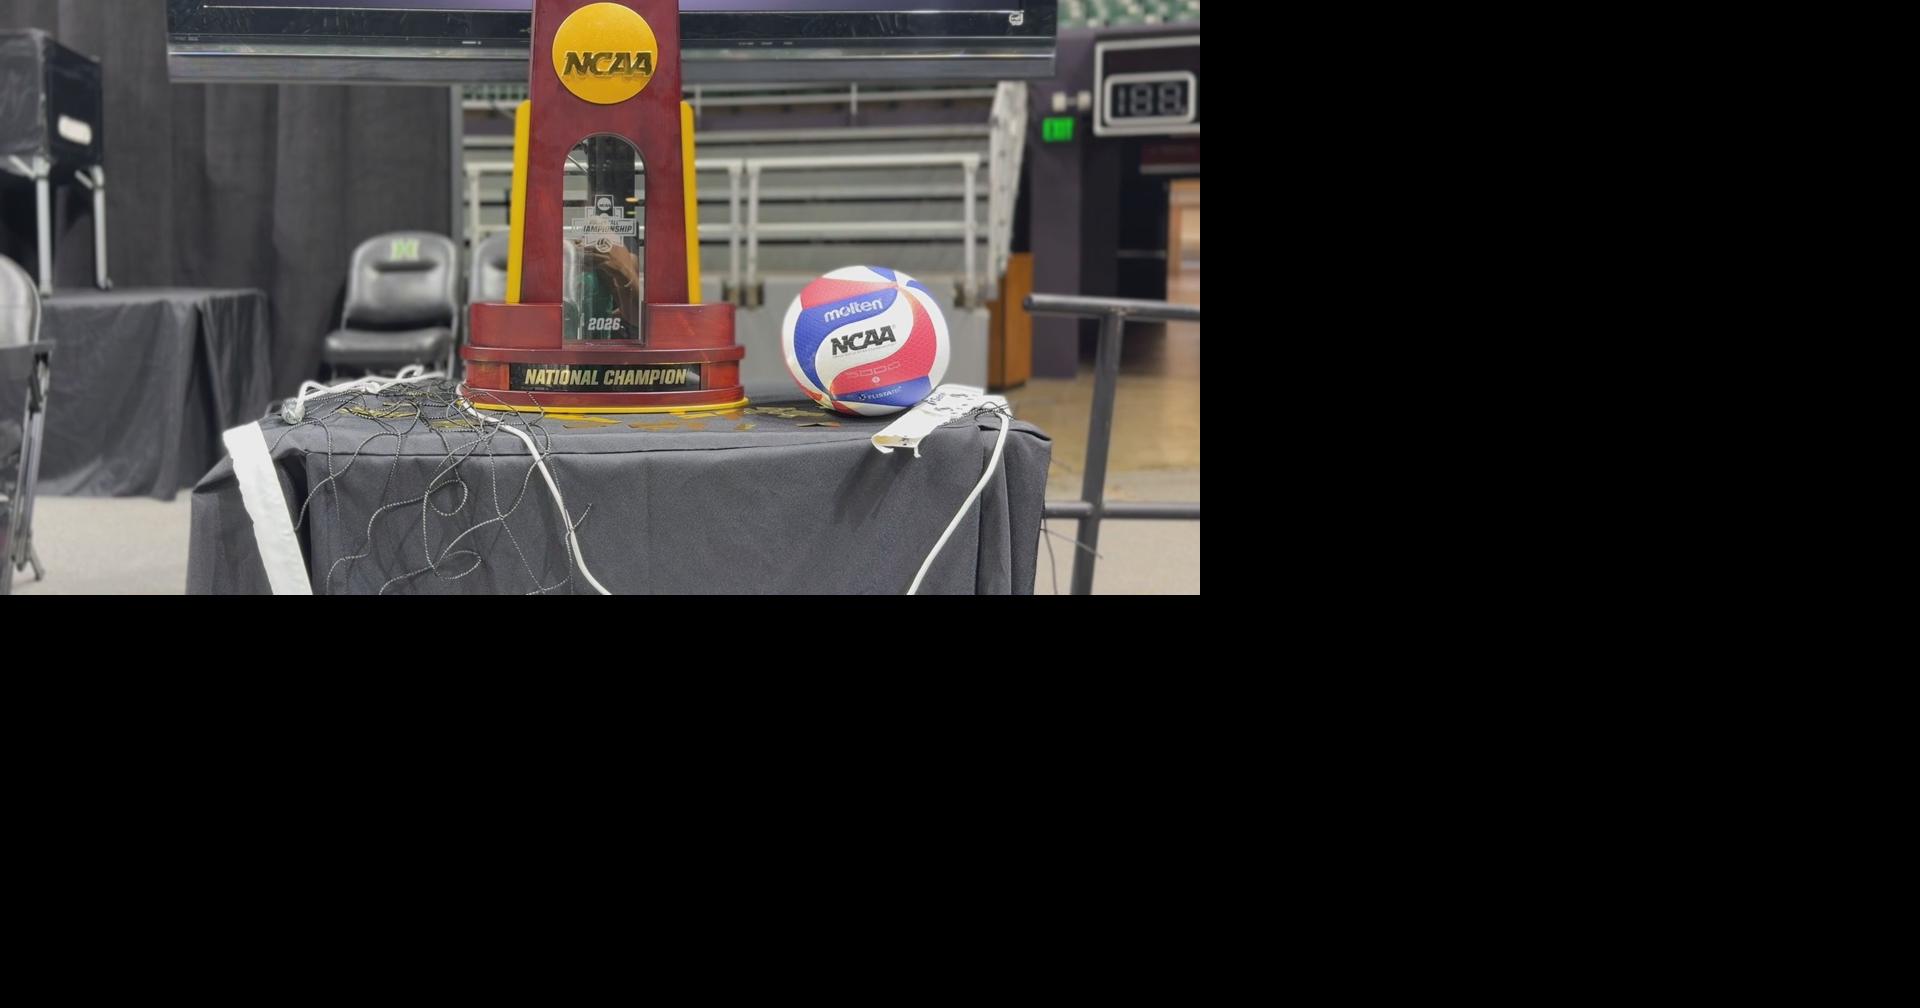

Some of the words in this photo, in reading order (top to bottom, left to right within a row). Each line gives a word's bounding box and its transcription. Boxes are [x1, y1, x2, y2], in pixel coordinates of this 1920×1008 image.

[563, 51, 653, 77] NCAA
[824, 298, 883, 323] molten
[588, 317, 621, 331] 2026
[831, 325, 896, 356] NCAA
[525, 369, 599, 386] NATIONAL
[603, 369, 687, 386] CHAMPION
